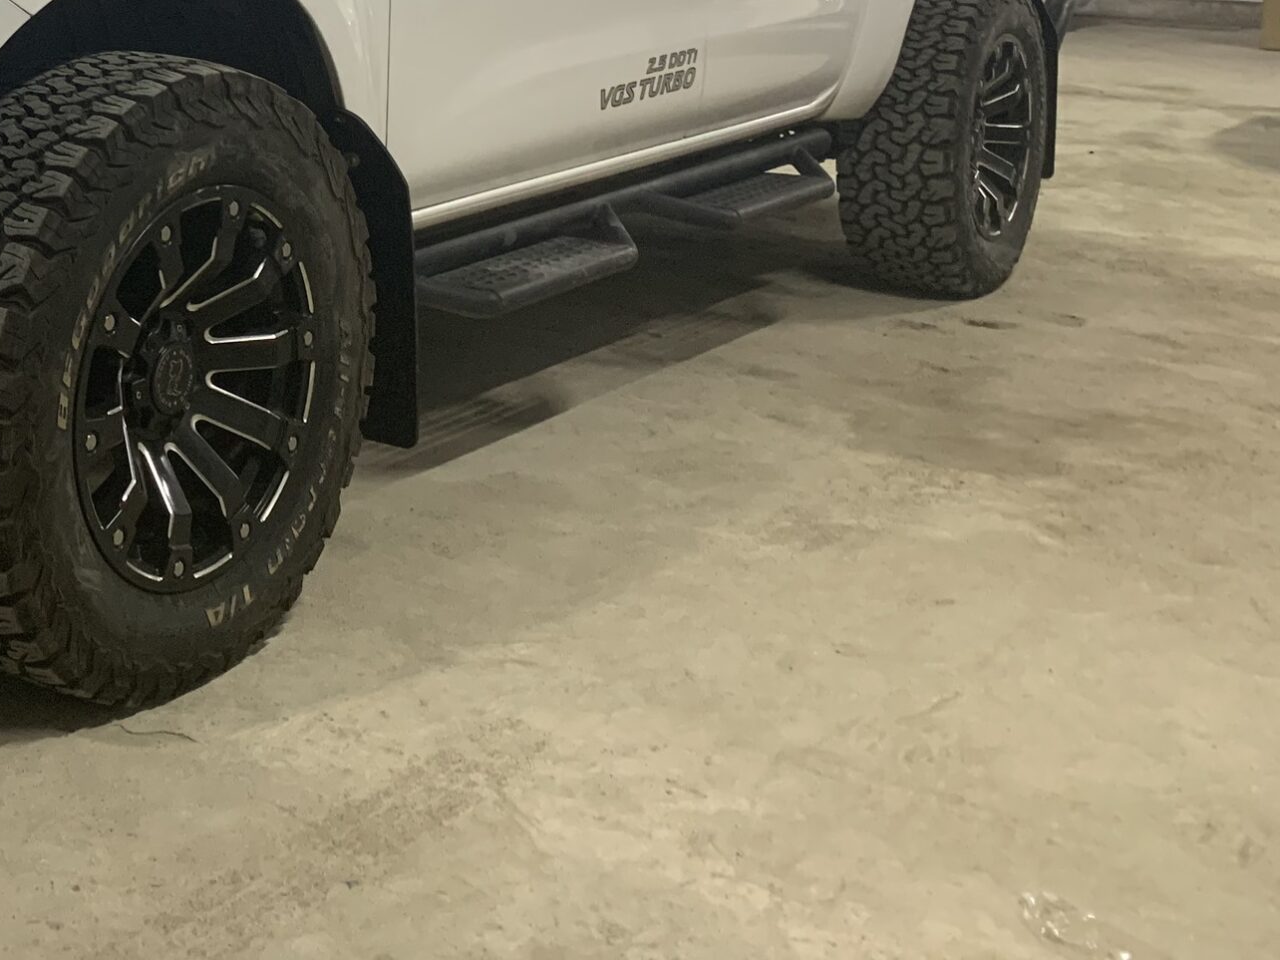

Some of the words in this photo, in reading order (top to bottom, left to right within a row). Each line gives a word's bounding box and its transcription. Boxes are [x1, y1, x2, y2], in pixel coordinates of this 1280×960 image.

[646, 53, 667, 75] 2.5
[600, 81, 637, 111] VGS
[639, 67, 697, 101] TURBO
